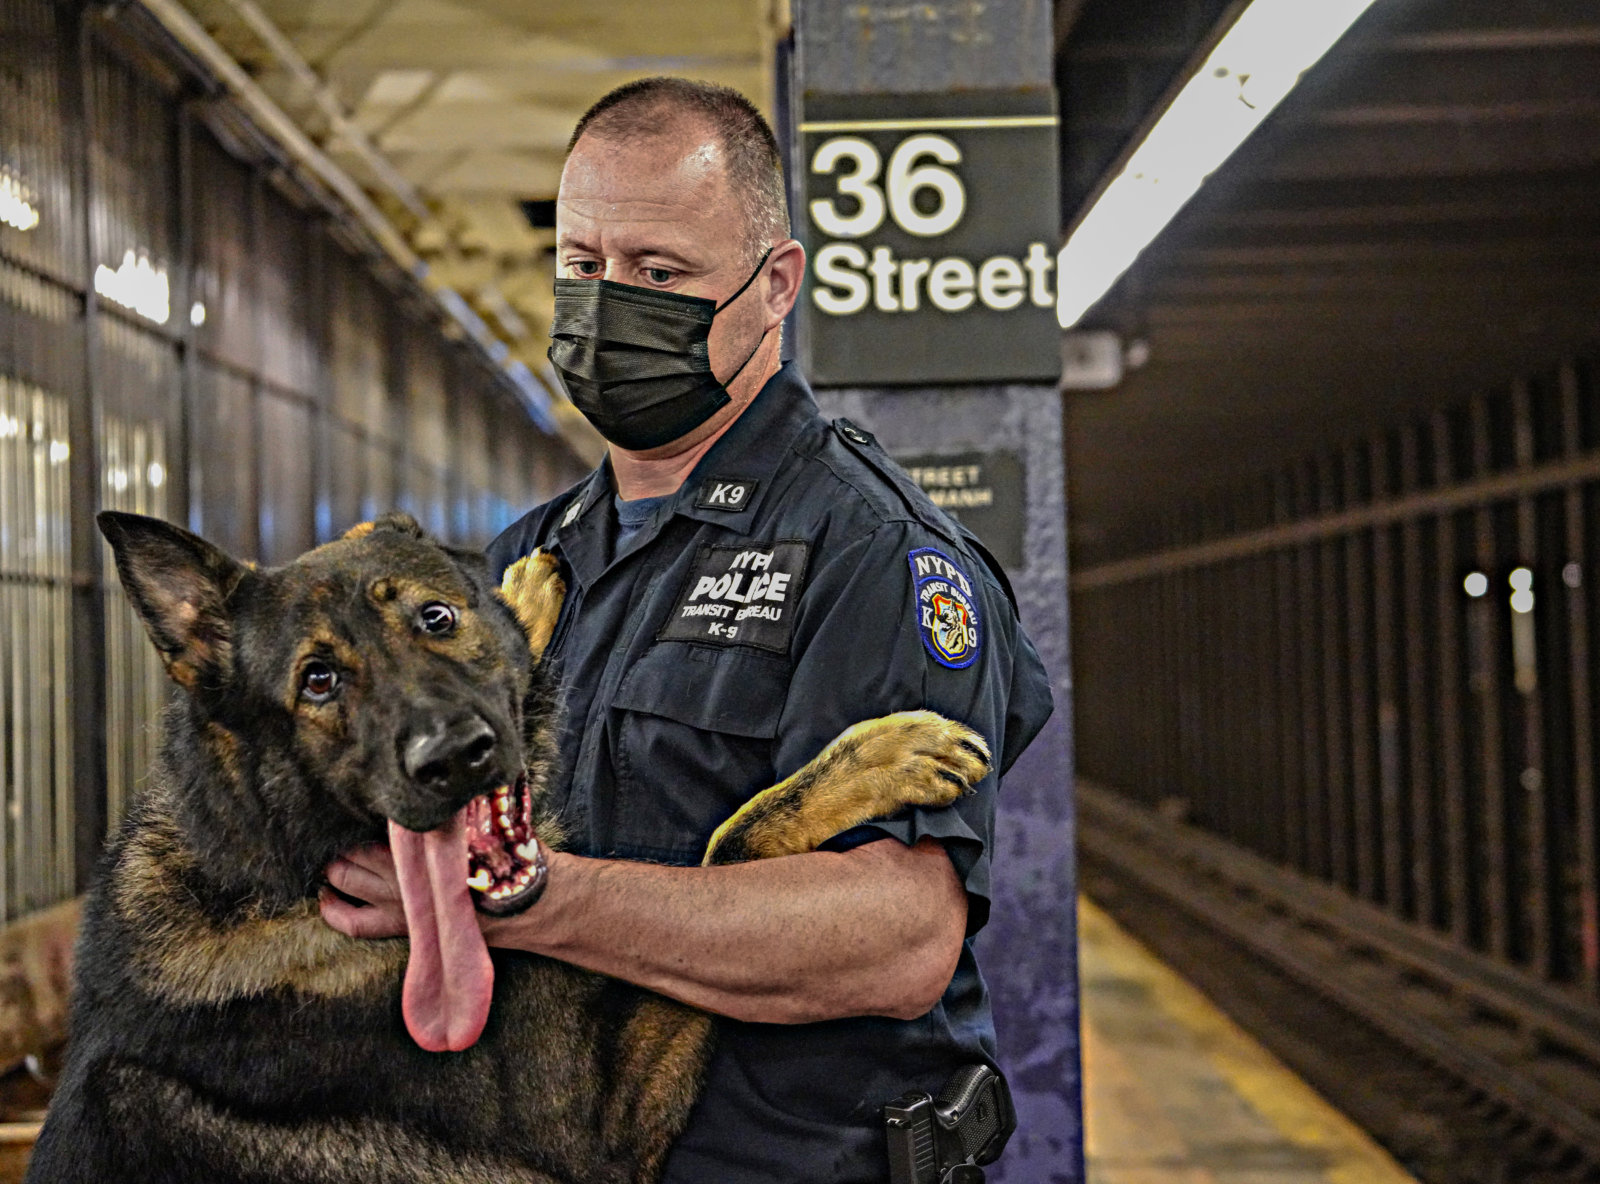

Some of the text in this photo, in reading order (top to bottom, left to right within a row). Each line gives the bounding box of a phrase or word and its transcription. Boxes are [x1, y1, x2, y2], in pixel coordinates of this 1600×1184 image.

[809, 134, 966, 238] 36
[812, 242, 1056, 316] Street
[906, 465, 979, 487] TREET
[708, 483, 745, 505] K9
[914, 554, 973, 597] NYPD
[688, 571, 791, 603] POLICE
[920, 581, 949, 602] TRANSIT
[681, 603, 783, 622] TRANSIT BREAU
[708, 621, 739, 639] K-9
